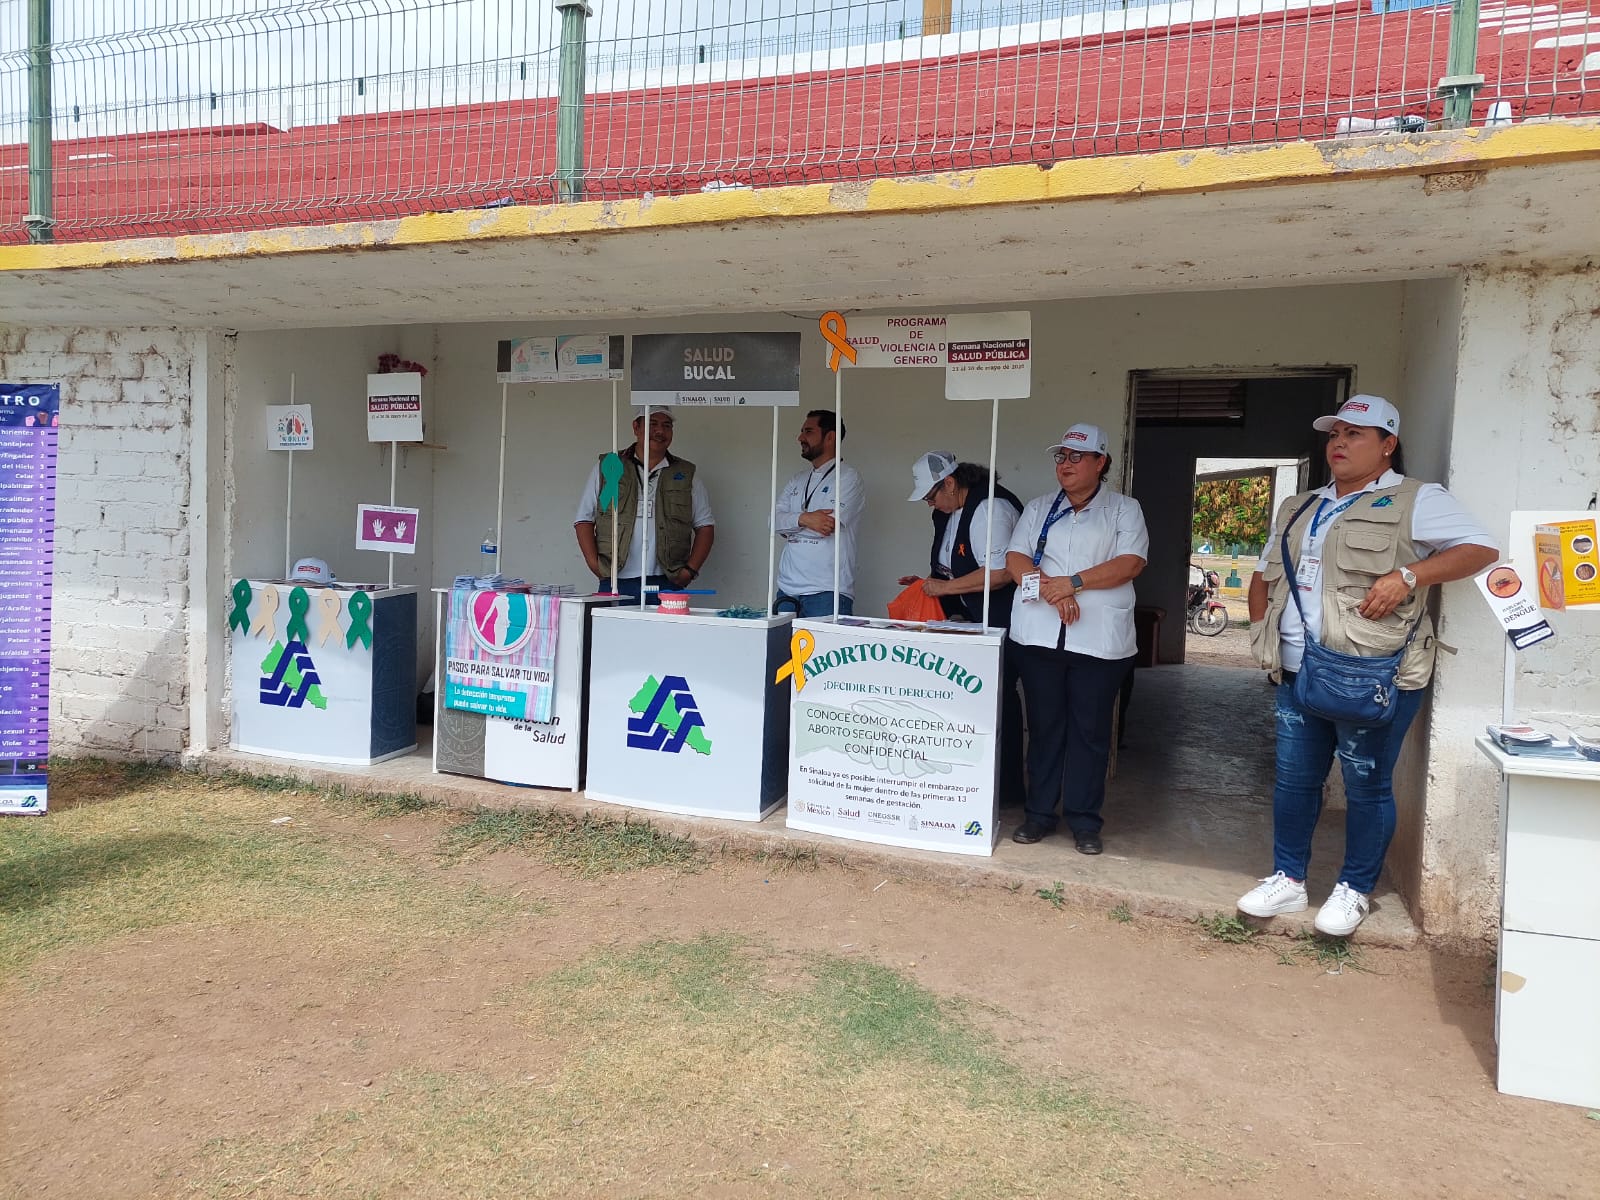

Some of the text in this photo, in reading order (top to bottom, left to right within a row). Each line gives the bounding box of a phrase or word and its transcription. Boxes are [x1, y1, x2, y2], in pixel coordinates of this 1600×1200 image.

[888, 318, 946, 327] PROGRAMA
[846, 336, 879, 345] SALUD
[910, 330, 924, 339] DE
[880, 343, 935, 352] VIOLENCIA
[952, 349, 1025, 360] SALUD PÚBLICA
[684, 348, 734, 362] SALUD
[894, 356, 937, 364] GENERO
[684, 366, 736, 380] BUCAL
[1504, 604, 1536, 624] DENGUE
[448, 660, 550, 683] PASOS PARA SALVAR TU VIDA
[803, 643, 983, 694] ABORTO SEGURO
[454, 686, 460, 694] La
[868, 684, 880, 693] ES
[882, 685, 896, 696] TU
[899, 687, 954, 700] DERECHO!
[807, 708, 850, 722] CONOCE
[890, 718, 943, 732] ACCEDER
[947, 722, 955, 732] A
[957, 723, 975, 734] UN
[533, 730, 566, 744] Salud
[808, 723, 973, 749] ABORTO SEGURO, GRATUITO Y
[844, 743, 928, 761] CONFIDENCIAL
[809, 766, 831, 776] Sinaloa
[851, 774, 875, 783] posible
[876, 776, 917, 789] interrumpir
[928, 783, 964, 792] embarazo
[808, 778, 834, 787] solicitud
[854, 784, 873, 793] mujer
[875, 787, 898, 795] dentro
[923, 792, 955, 802] primeras
[845, 794, 874, 804] semanas
[838, 808, 860, 817] Salud
[921, 820, 956, 829] SINALOA
